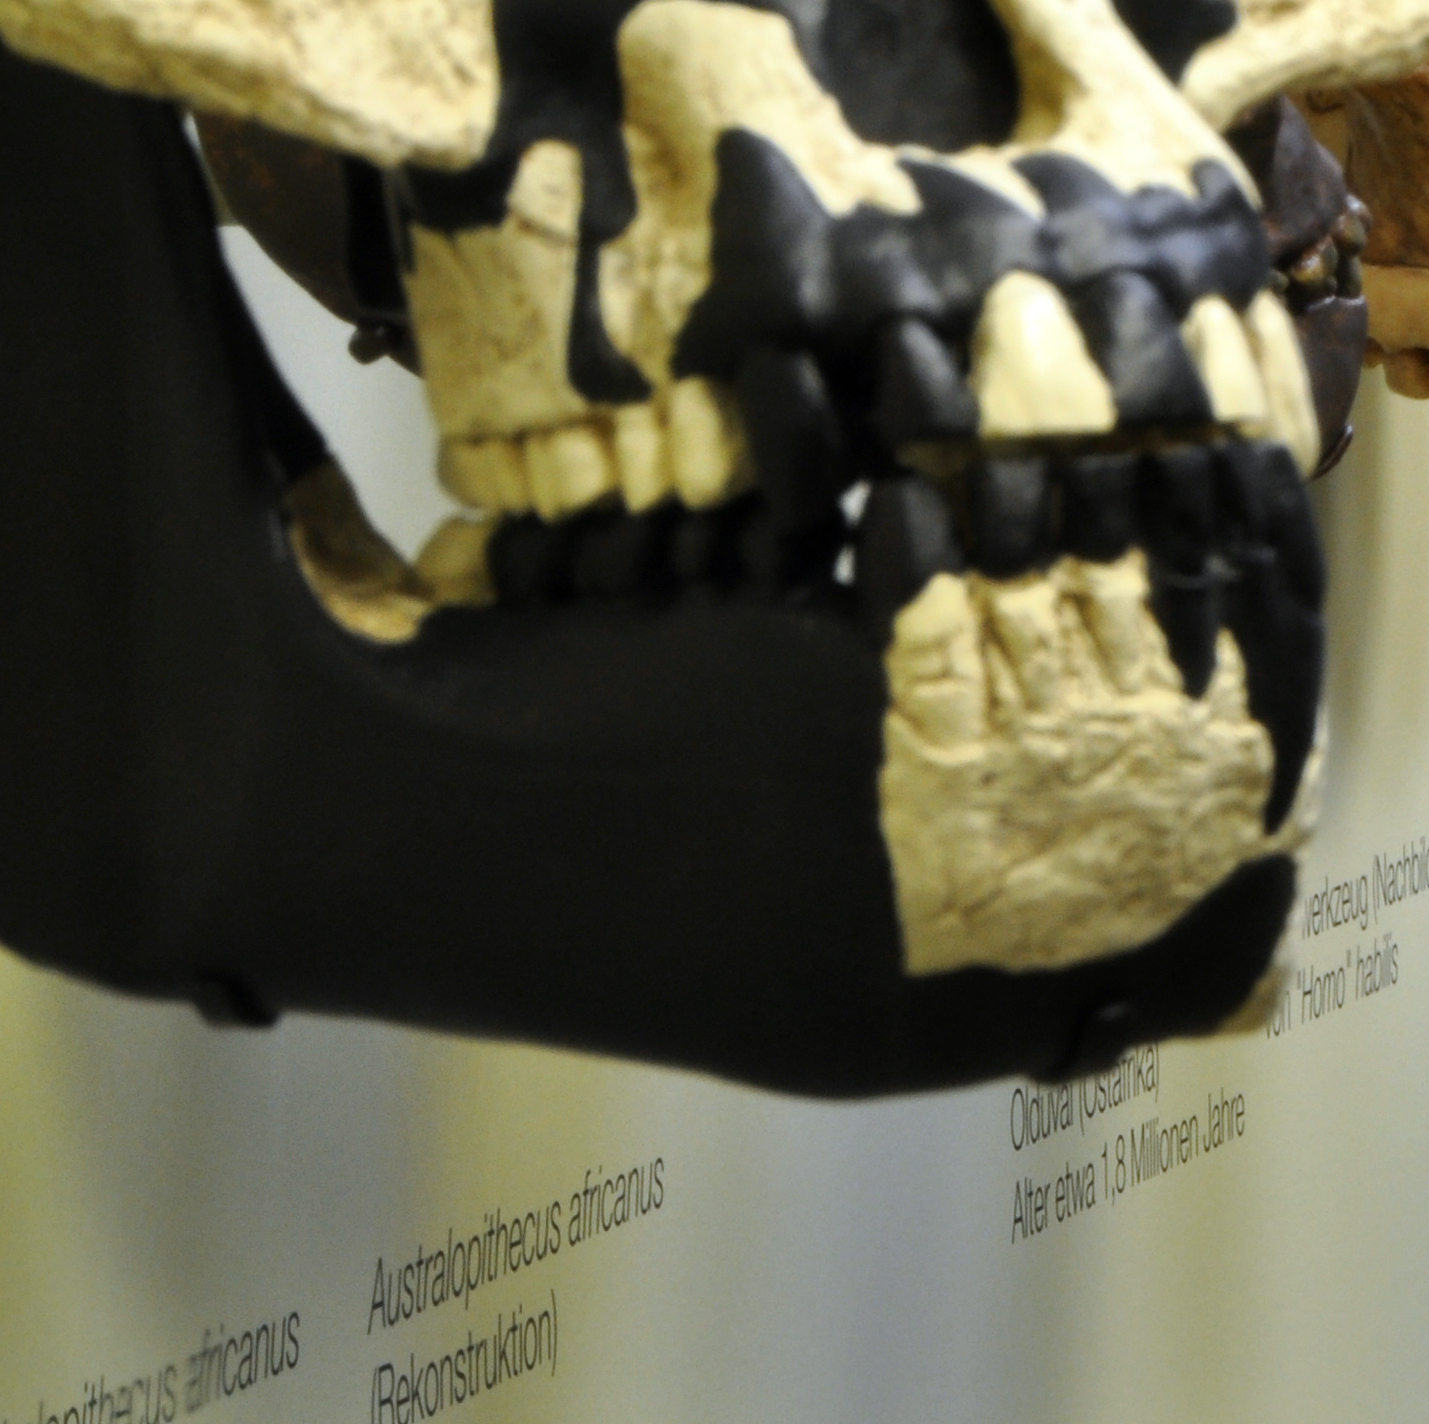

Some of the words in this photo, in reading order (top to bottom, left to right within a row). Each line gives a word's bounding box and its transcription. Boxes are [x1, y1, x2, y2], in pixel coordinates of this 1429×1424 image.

[1011, 1176, 1051, 1245] Alter
[1055, 1161, 1096, 1223] etwa
[1101, 1135, 1126, 1207] 1,8
[1130, 1115, 1199, 1188] Millionen
[1203, 1087, 1246, 1154] Jahre
[366, 1200, 561, 1336] Australopithecus
[568, 1157, 665, 1246] africanus
[184, 1311, 300, 1415] africanus
[370, 1288, 558, 1424] (Rekonstruktion)
